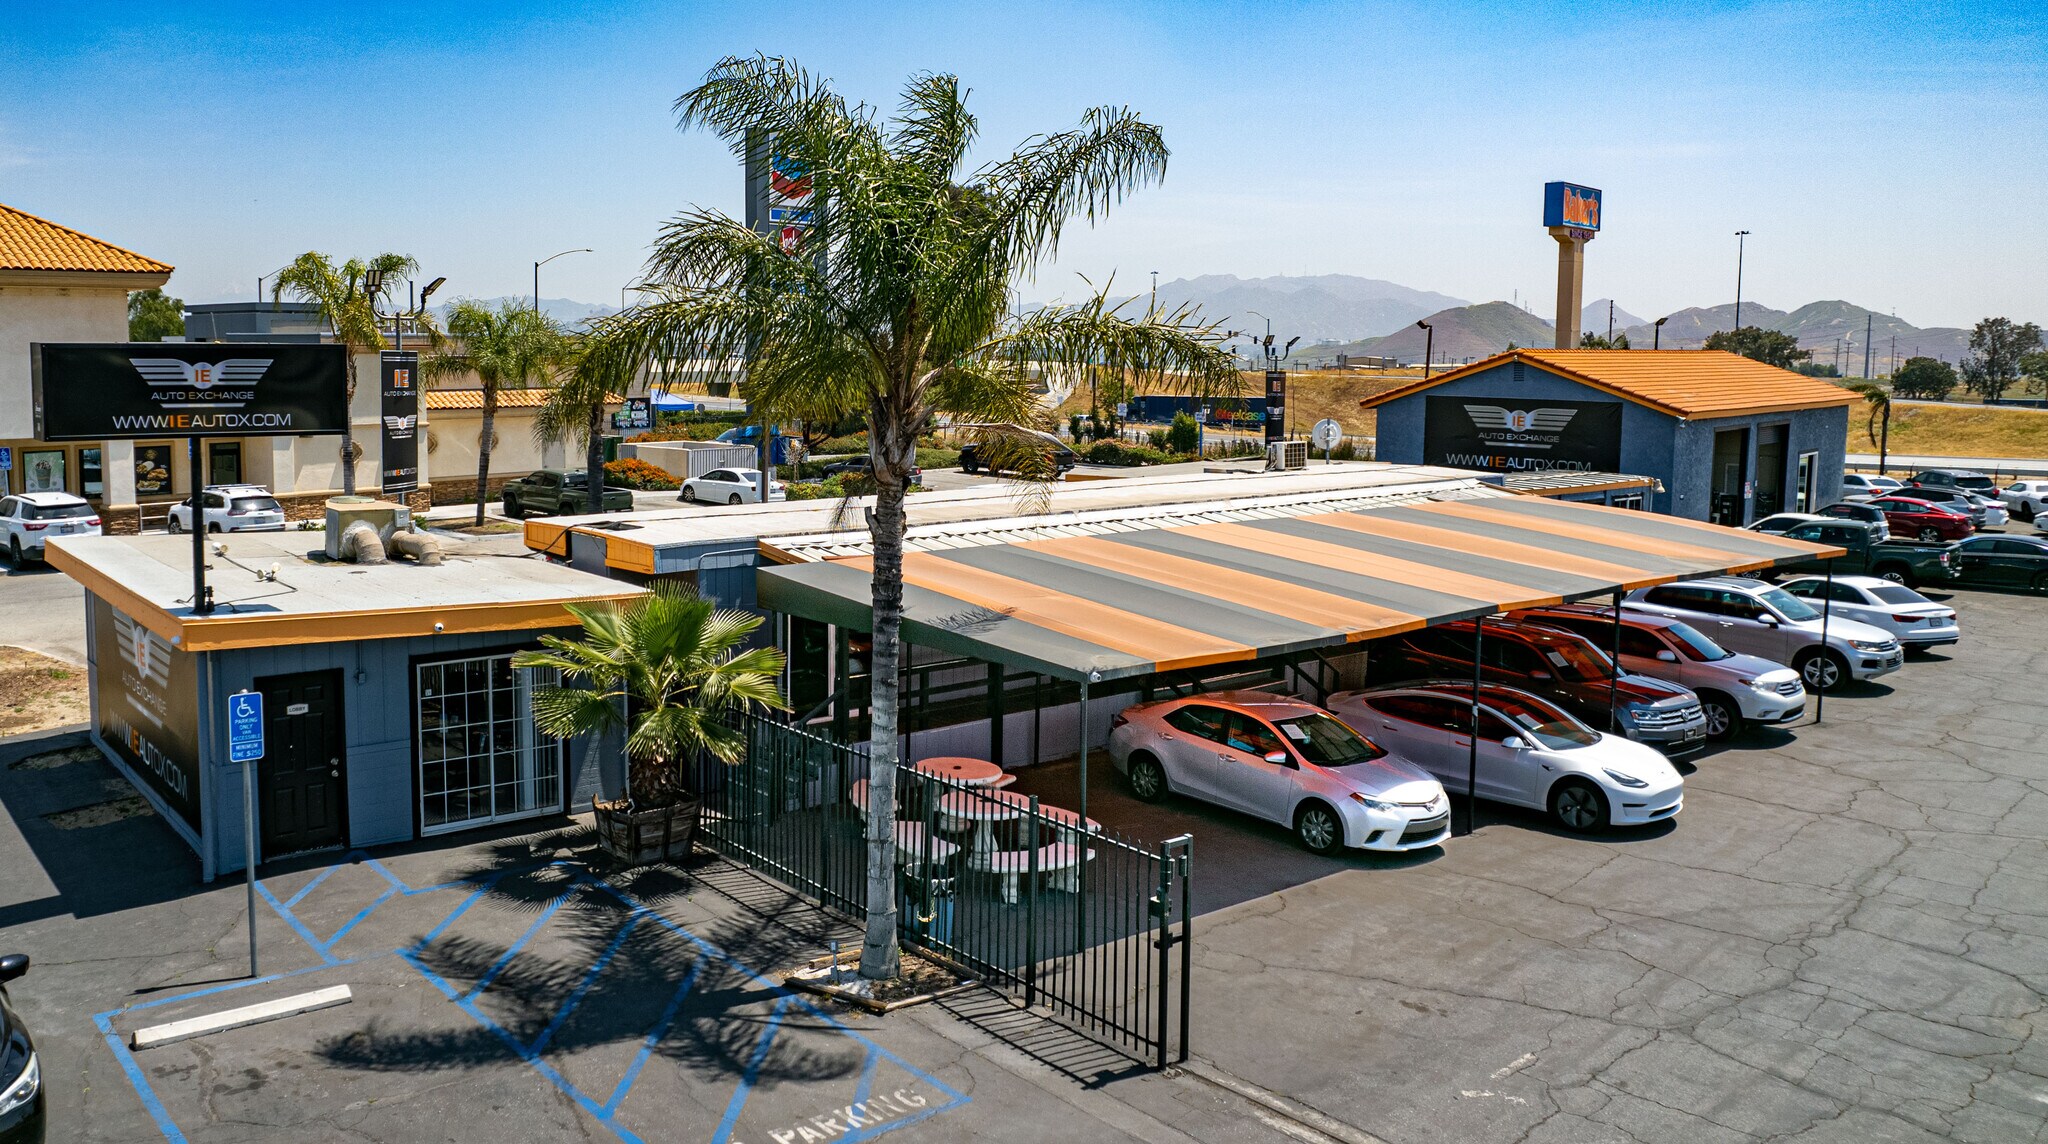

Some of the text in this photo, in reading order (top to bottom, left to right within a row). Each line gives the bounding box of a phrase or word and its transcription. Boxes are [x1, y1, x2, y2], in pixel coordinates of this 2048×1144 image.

[1564, 188, 1598, 226] Baker's
[195, 370, 211, 382] IE
[394, 369, 409, 387] IE
[151, 391, 254, 400] AUTO EXCHANGE
[1512, 416, 1526, 427] IE
[1478, 432, 1560, 443] AUTO EXCHANGE
[136, 642, 146, 668] IE
[121, 670, 168, 716] AUTO EXCHANGE
[233, 733, 262, 741] ACCESSIBLE
[767, 1088, 926, 1144] PARKING
